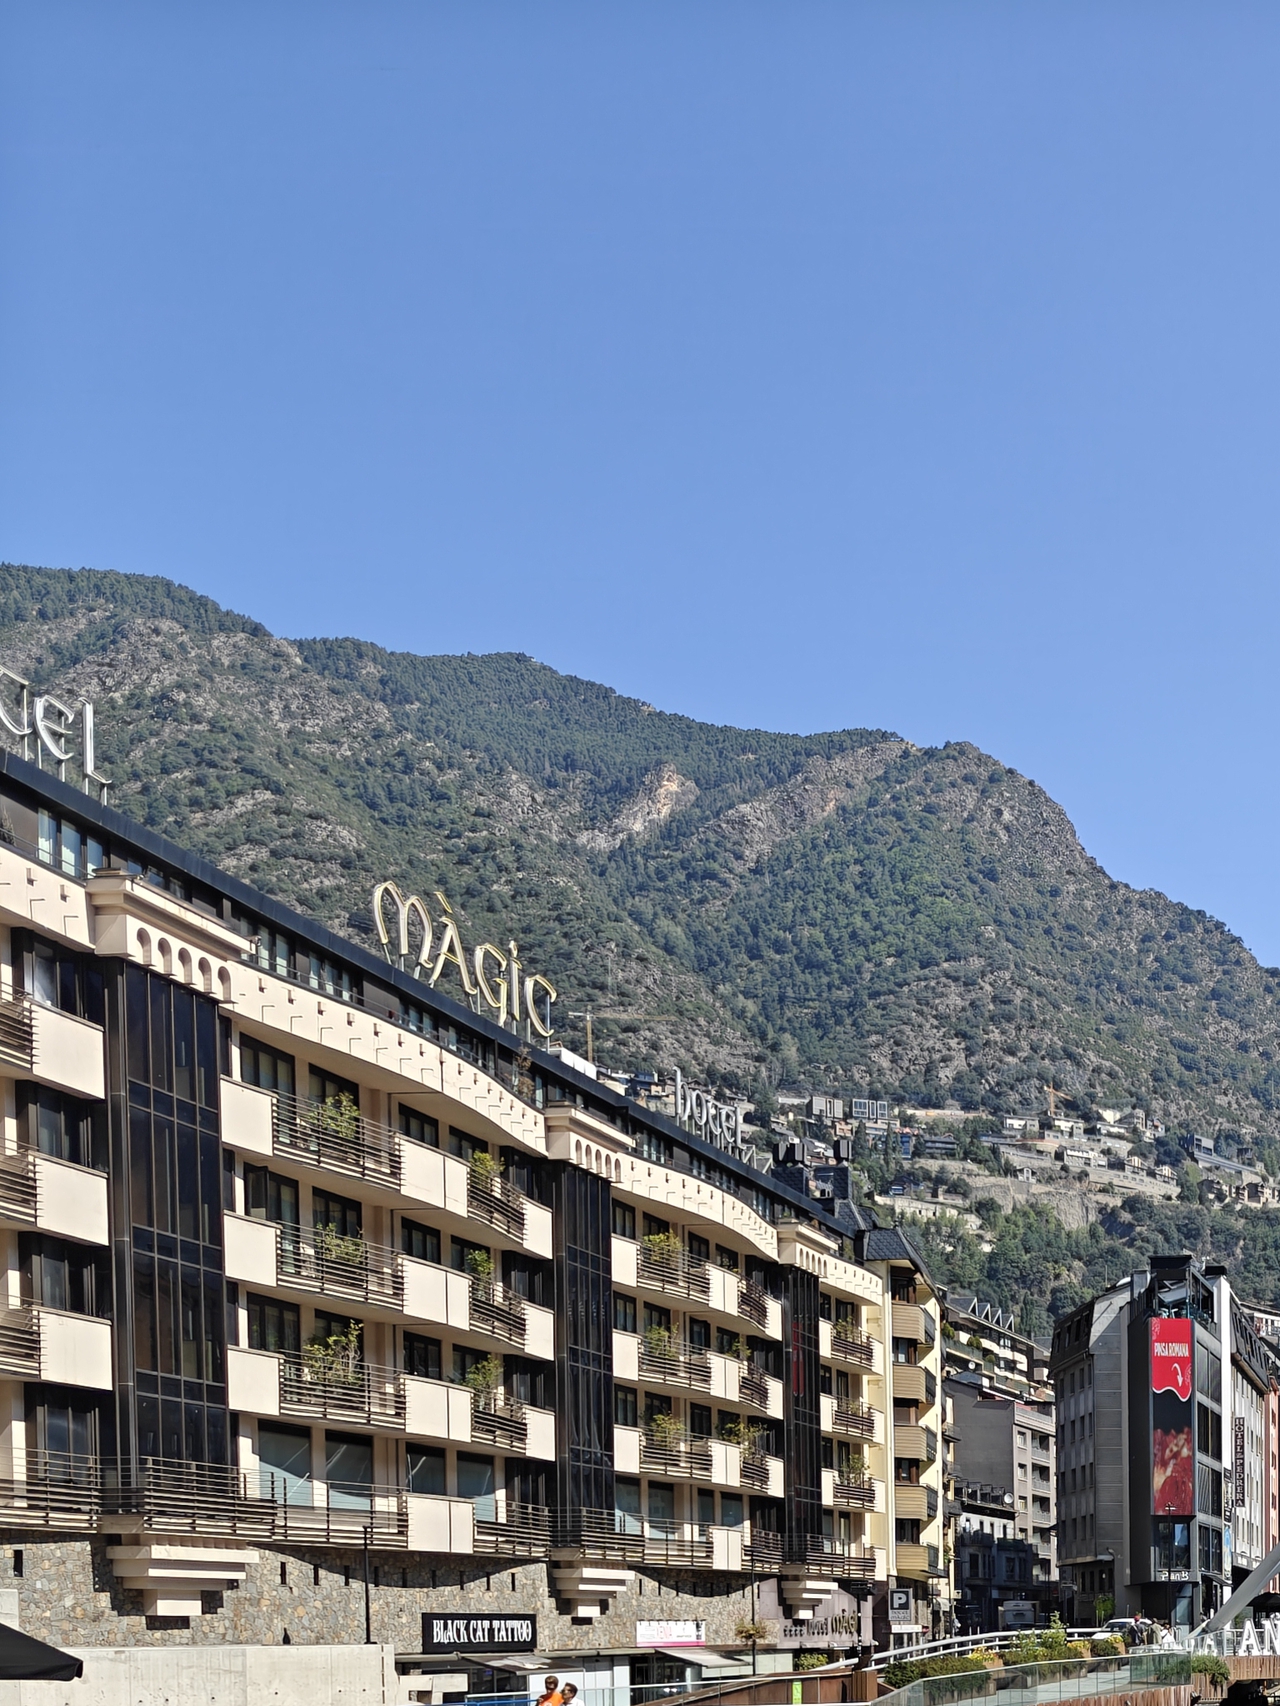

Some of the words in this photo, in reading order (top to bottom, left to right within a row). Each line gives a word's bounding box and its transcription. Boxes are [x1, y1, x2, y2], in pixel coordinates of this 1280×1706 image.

[1154, 1342, 1168, 1357] PINSA
[1169, 1342, 1190, 1358] ROMANA
[1236, 1418, 1245, 1451] HOTEL
[1236, 1459, 1245, 1506] PEDRERA
[893, 1593, 907, 1608] P
[432, 1619, 469, 1644] BLACK
[469, 1620, 490, 1643] CAT
[492, 1620, 532, 1642] TATTOO
